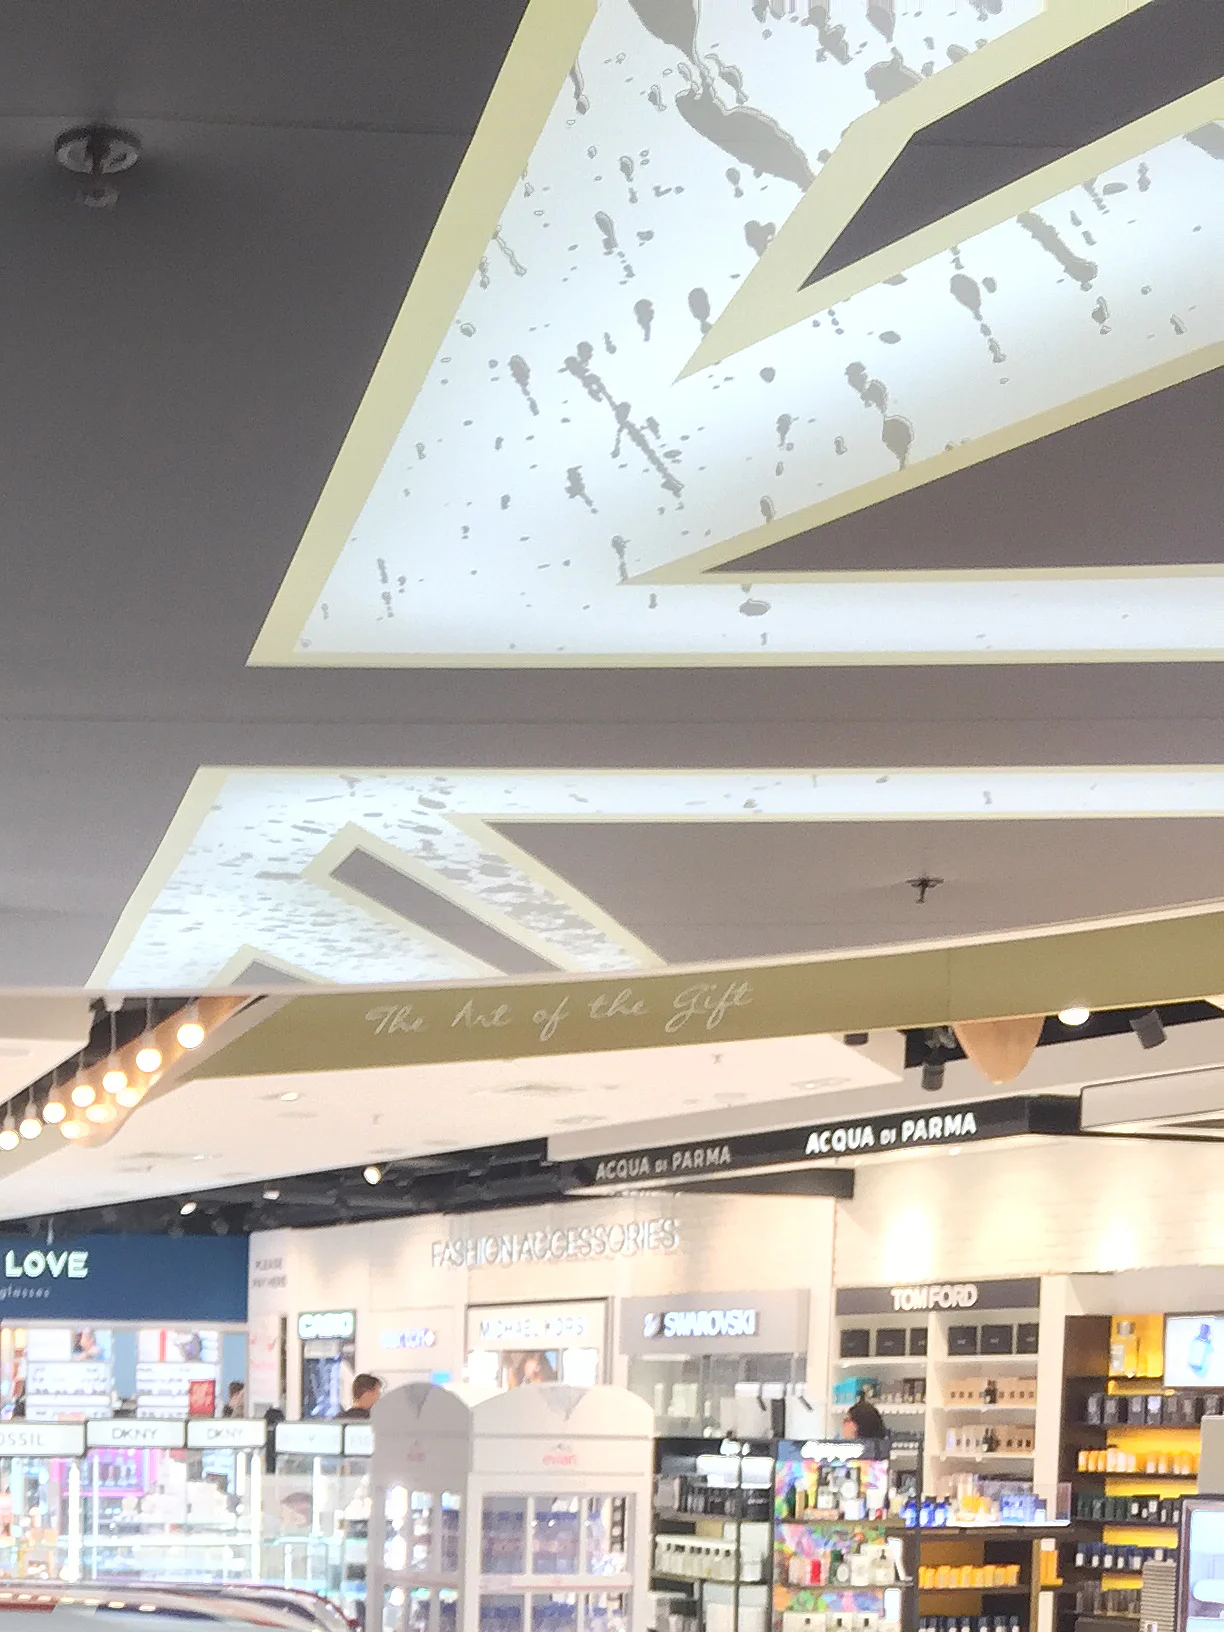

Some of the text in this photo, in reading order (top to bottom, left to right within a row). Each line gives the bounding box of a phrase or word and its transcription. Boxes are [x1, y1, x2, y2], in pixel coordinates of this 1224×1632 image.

[364, 981, 754, 1042] The Art of the Gift
[805, 1124, 875, 1156] ACQUA
[901, 1111, 977, 1144] PARMA
[595, 1155, 651, 1183] ACQUA
[672, 1144, 732, 1172] PARMA
[432, 1217, 680, 1268] FASHION ACCESSORIES
[4, 1249, 89, 1278] LOVE
[890, 1284, 979, 1312] TOM FORD
[663, 1308, 757, 1338] SWAROVSKI
[111, 1427, 159, 1441] DKNY
[206, 1427, 244, 1441] DKNY
